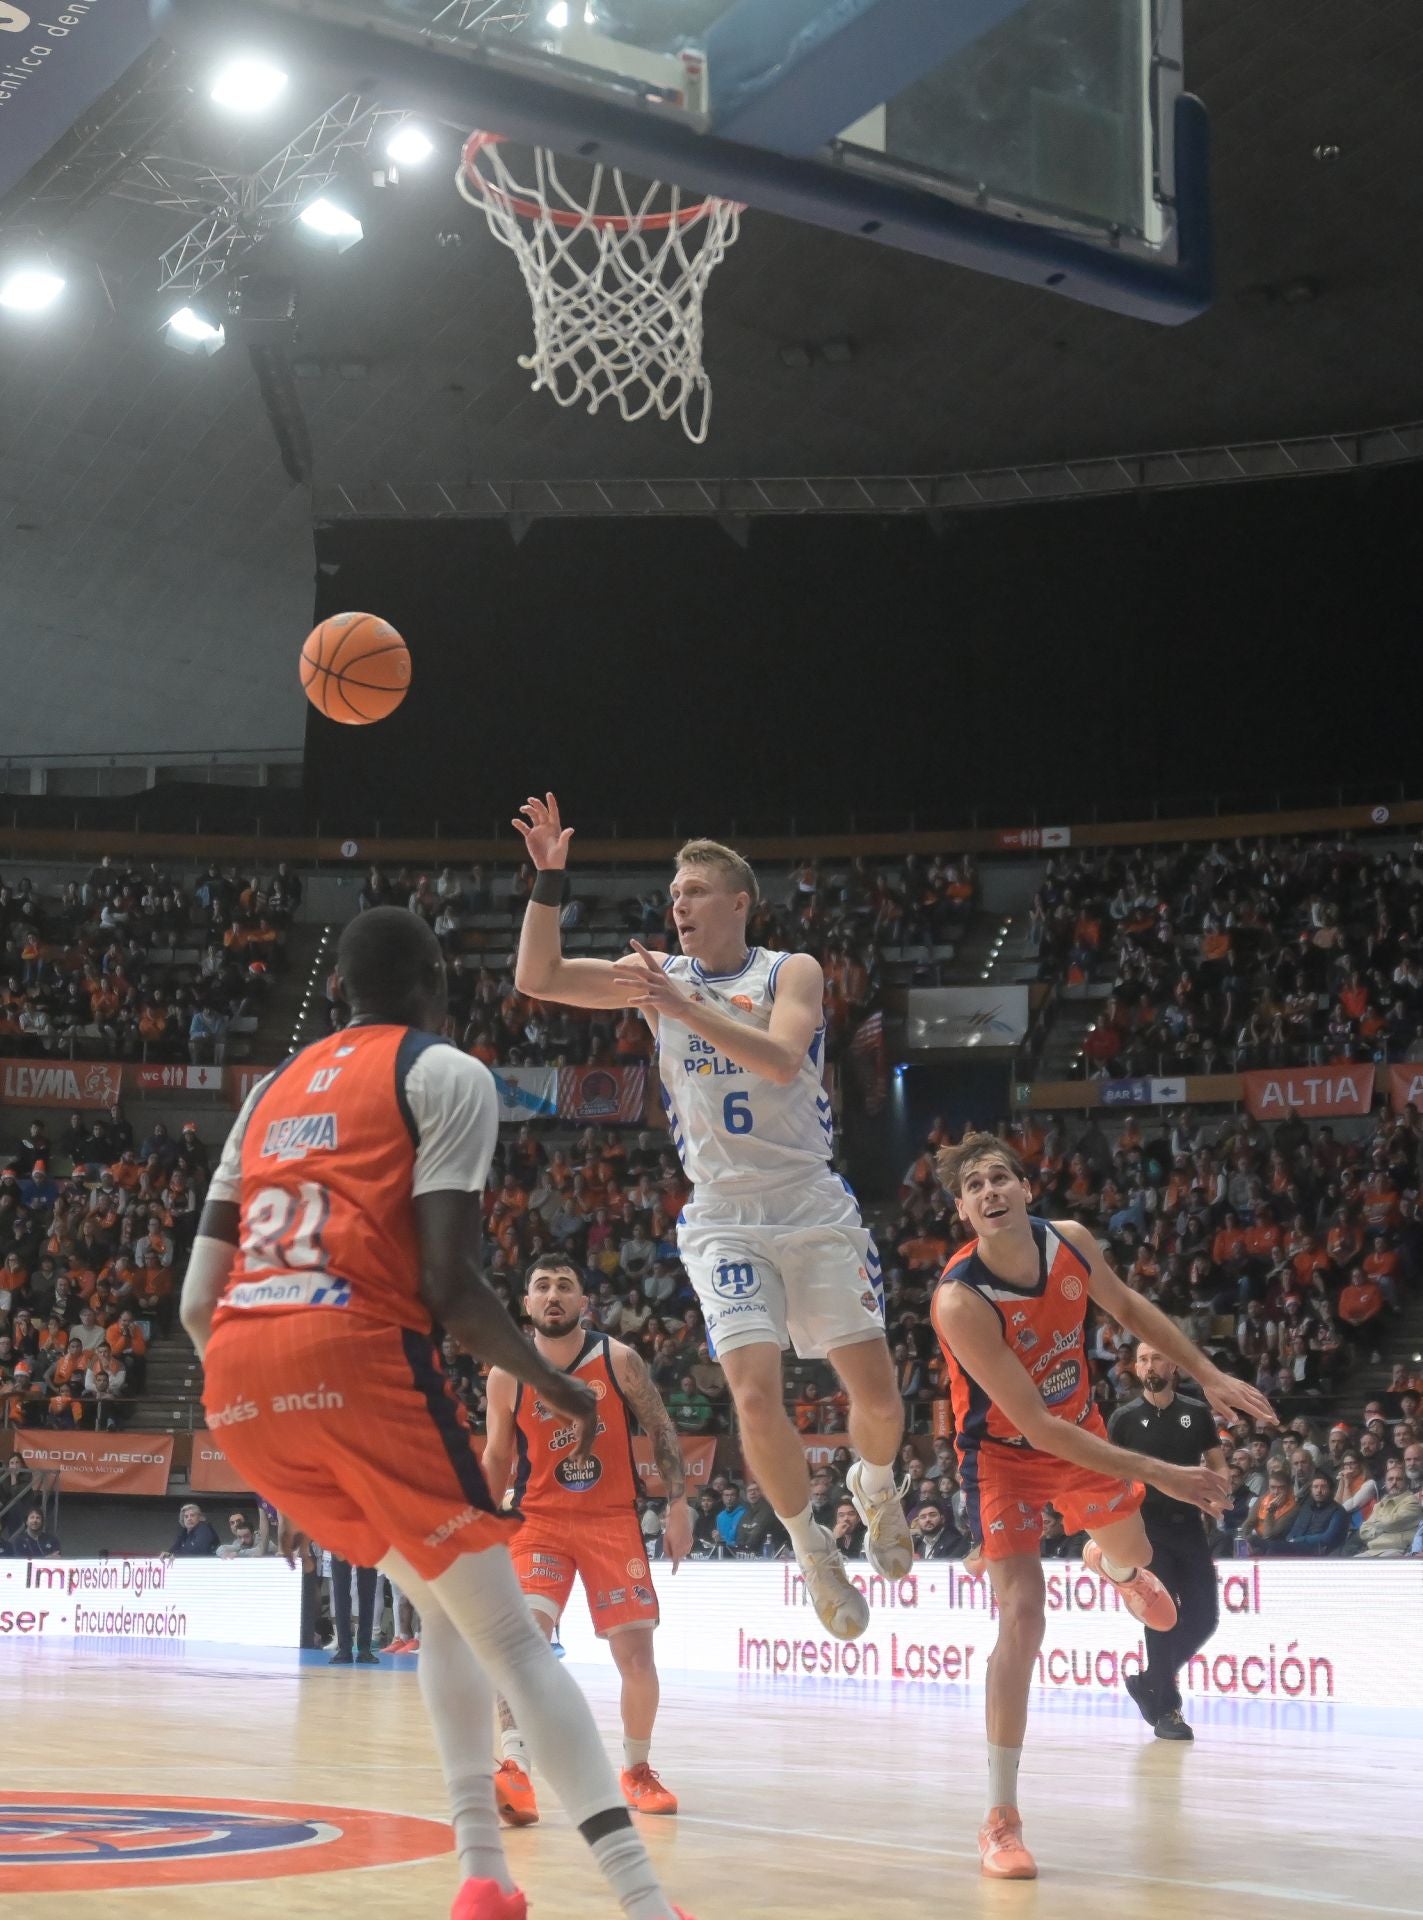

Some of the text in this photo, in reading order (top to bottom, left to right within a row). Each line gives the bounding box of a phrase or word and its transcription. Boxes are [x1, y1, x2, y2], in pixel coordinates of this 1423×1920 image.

[38, 0, 97, 36] den
[5, 1066, 81, 1100] LEYMA
[141, 1071, 160, 1081] WC
[1261, 1077, 1359, 1108] ALTIA
[1104, 1089, 1131, 1101] BAR
[723, 1091, 754, 1135] 6
[261, 1112, 338, 1158] LEYMA
[240, 1181, 328, 1273] 21
[272, 1382, 345, 1413] ancín
[22, 1448, 88, 1462] OMODA
[564, 1469, 595, 1481] Galicia
[26, 1559, 166, 1598] Impresión Digital
[0, 1604, 187, 1637] ser Encuadernación
[891, 1632, 976, 1680] Laser
[1031, 1639, 1334, 1697] ncuadnación
